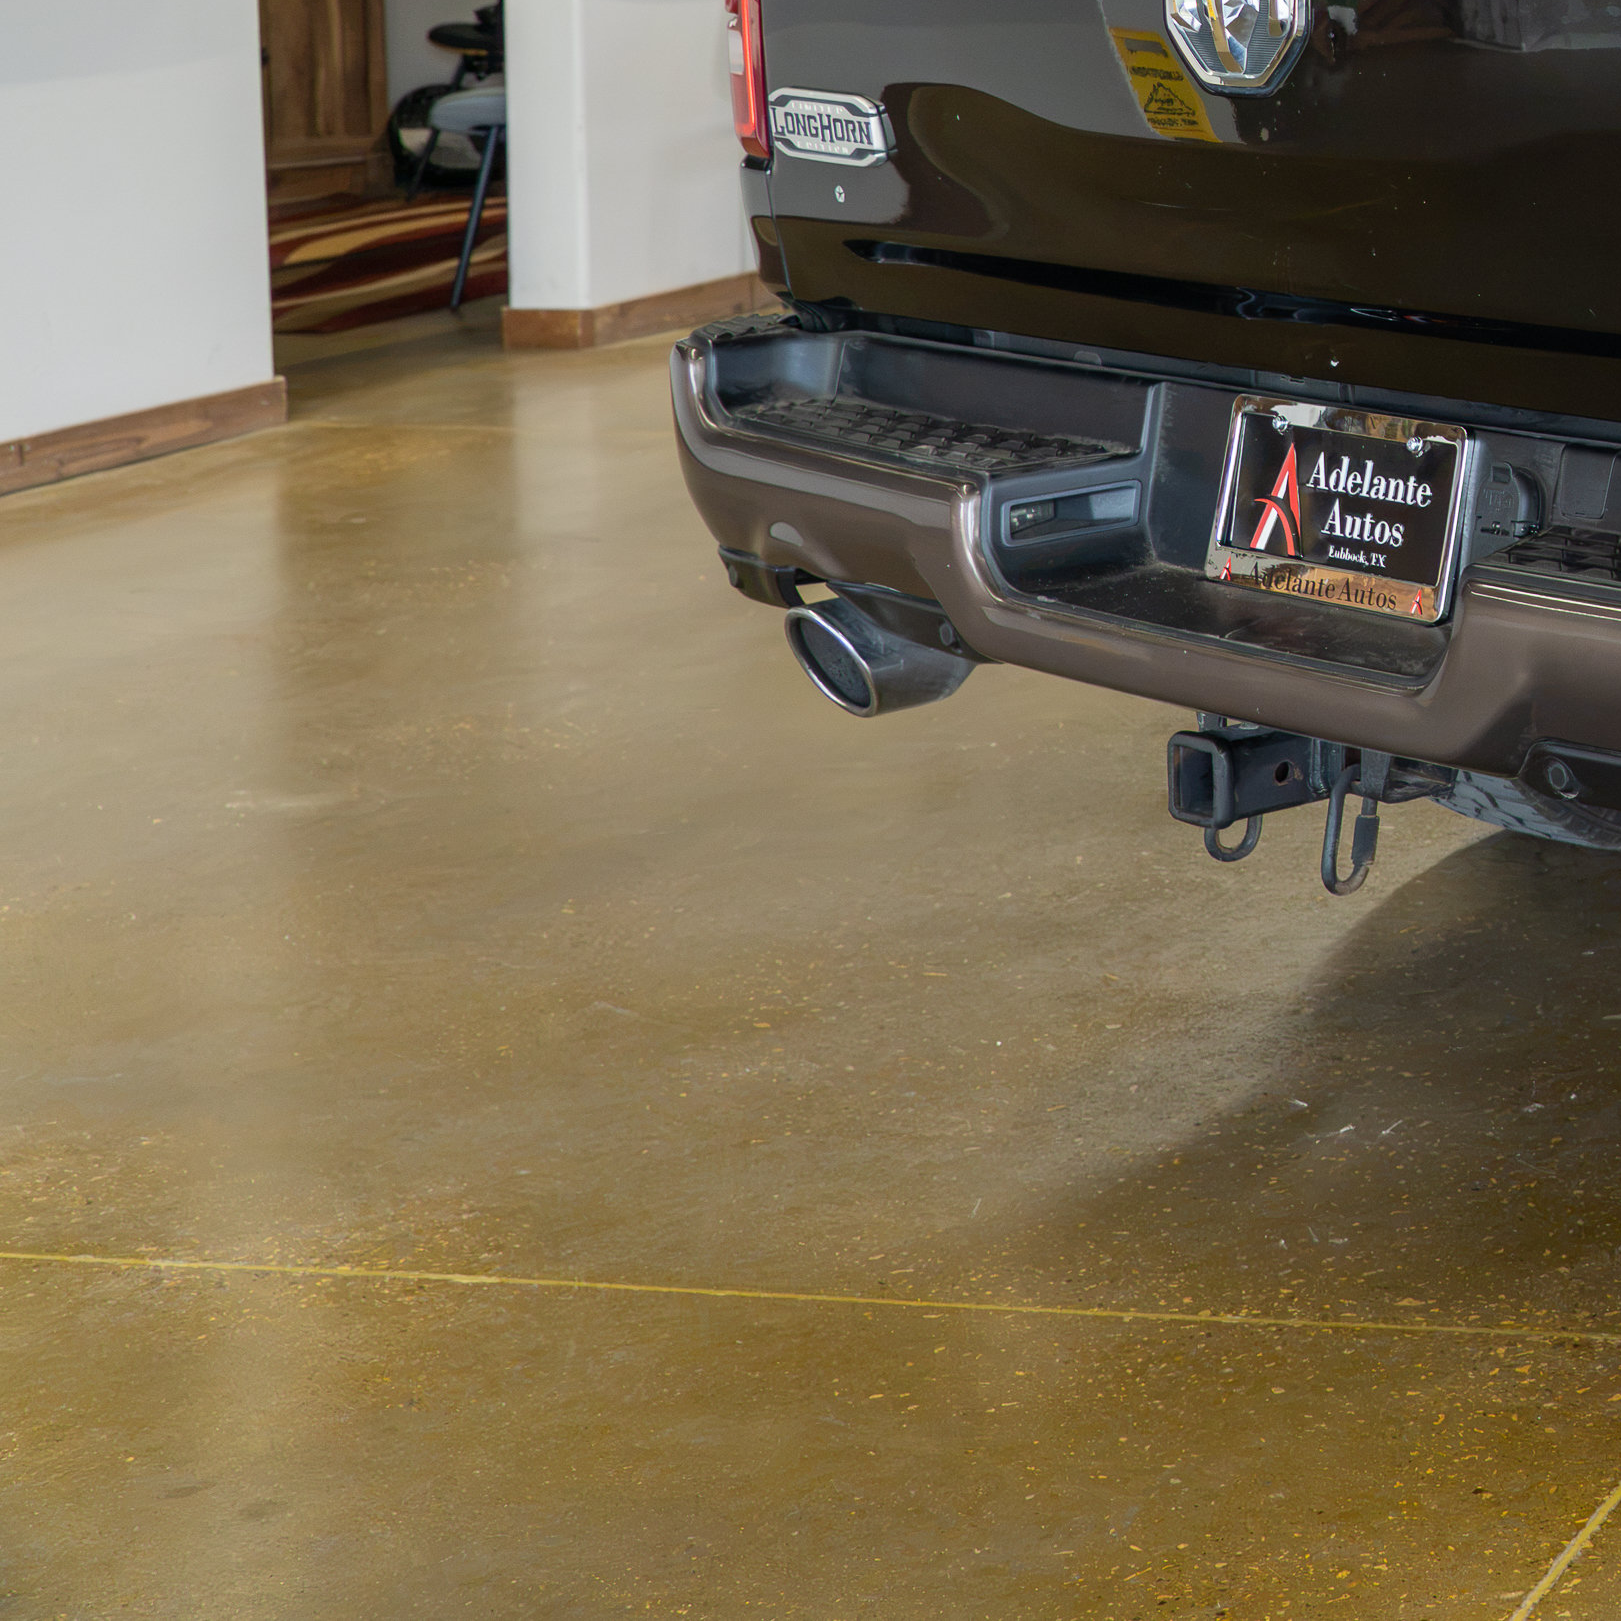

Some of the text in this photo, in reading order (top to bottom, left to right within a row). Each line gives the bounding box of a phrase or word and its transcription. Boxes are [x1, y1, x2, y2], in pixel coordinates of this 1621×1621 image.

[1305, 450, 1433, 508] Adelante
[1320, 497, 1406, 549] Autos
[1250, 560, 1337, 600] Adelante
[1337, 582, 1398, 612] Autos
